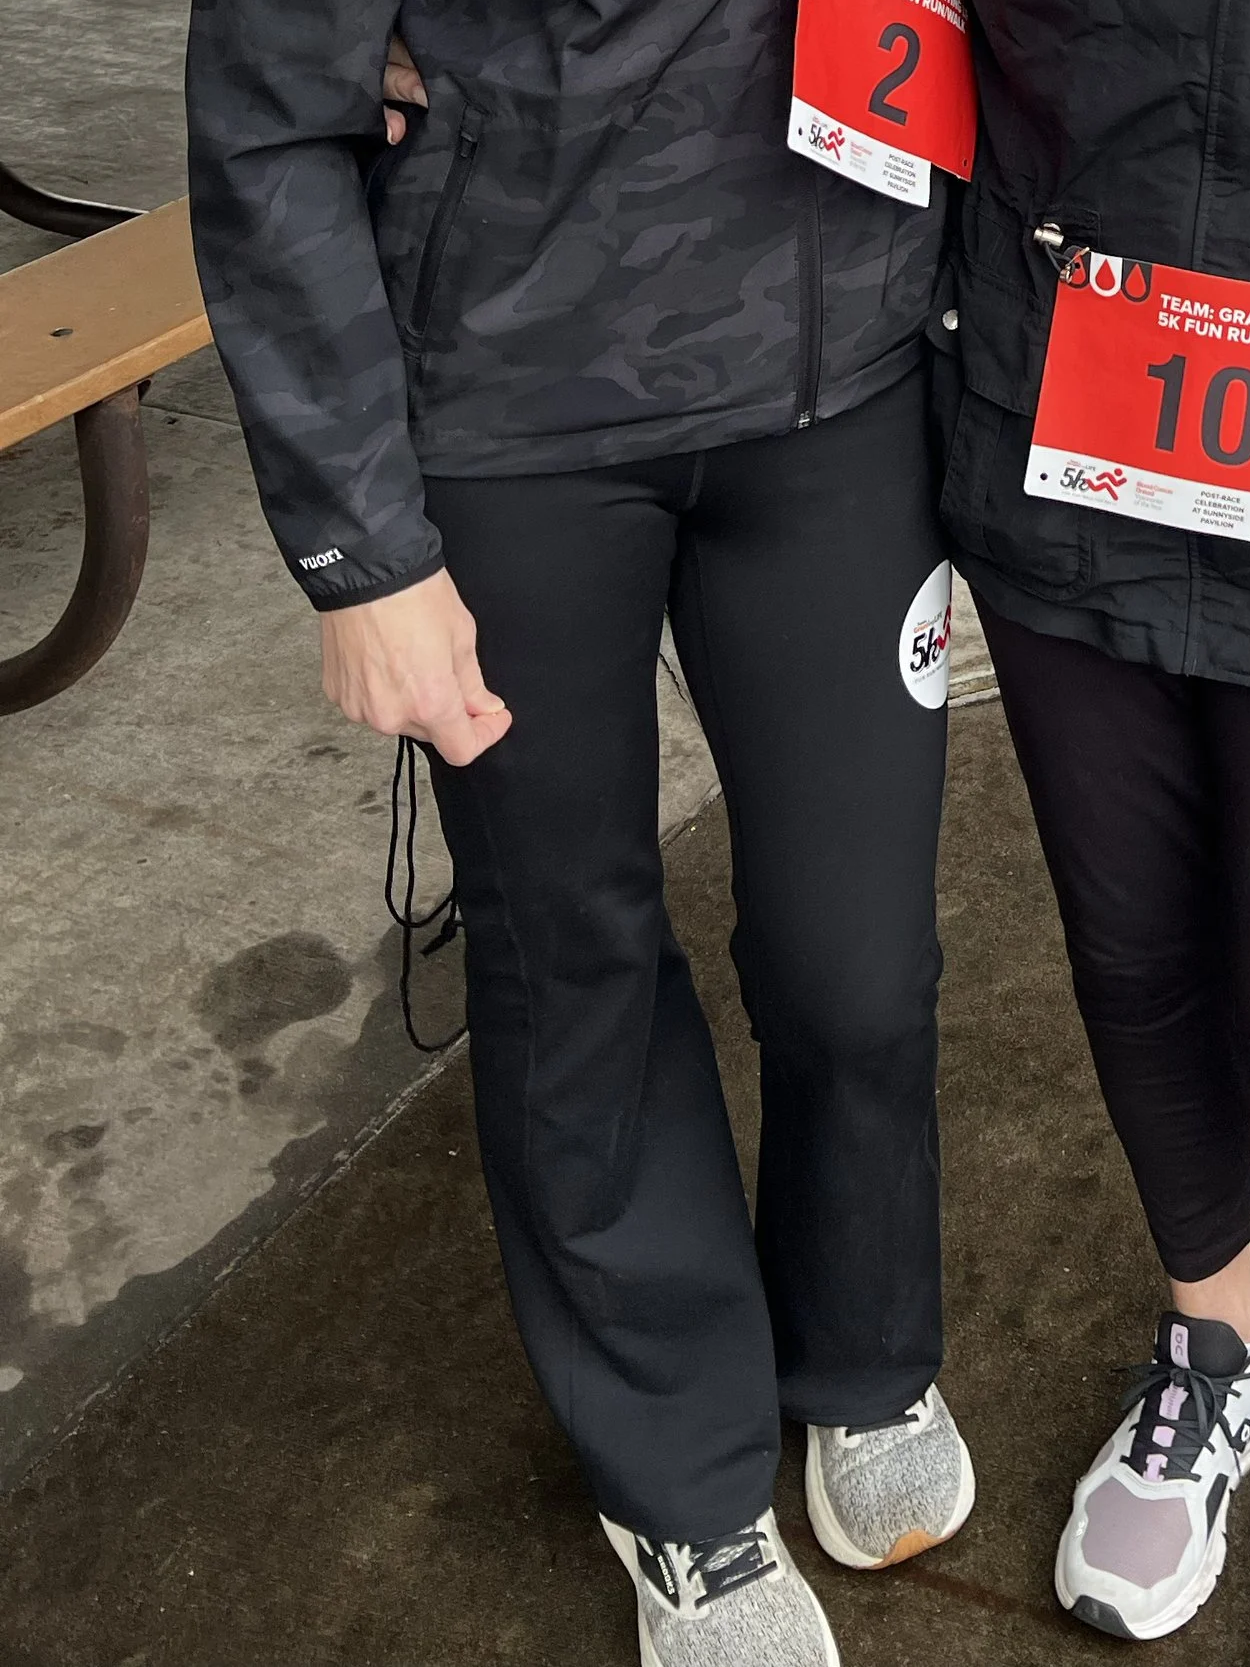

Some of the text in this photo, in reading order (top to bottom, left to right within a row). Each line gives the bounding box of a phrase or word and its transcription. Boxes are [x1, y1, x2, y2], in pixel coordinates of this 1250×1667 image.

[867, 22, 921, 127] 2
[1160, 293, 1215, 320] TEAM:
[1158, 311, 1181, 331] 5K
[1184, 319, 1223, 339] FUN
[1195, 499, 1245, 513] CELEBRATION
[1200, 491, 1241, 503] POST-RACE
[1200, 517, 1234, 528] PAVILION
[1203, 509, 1245, 522] SUNNYSIDE
[298, 547, 344, 571] vuori
